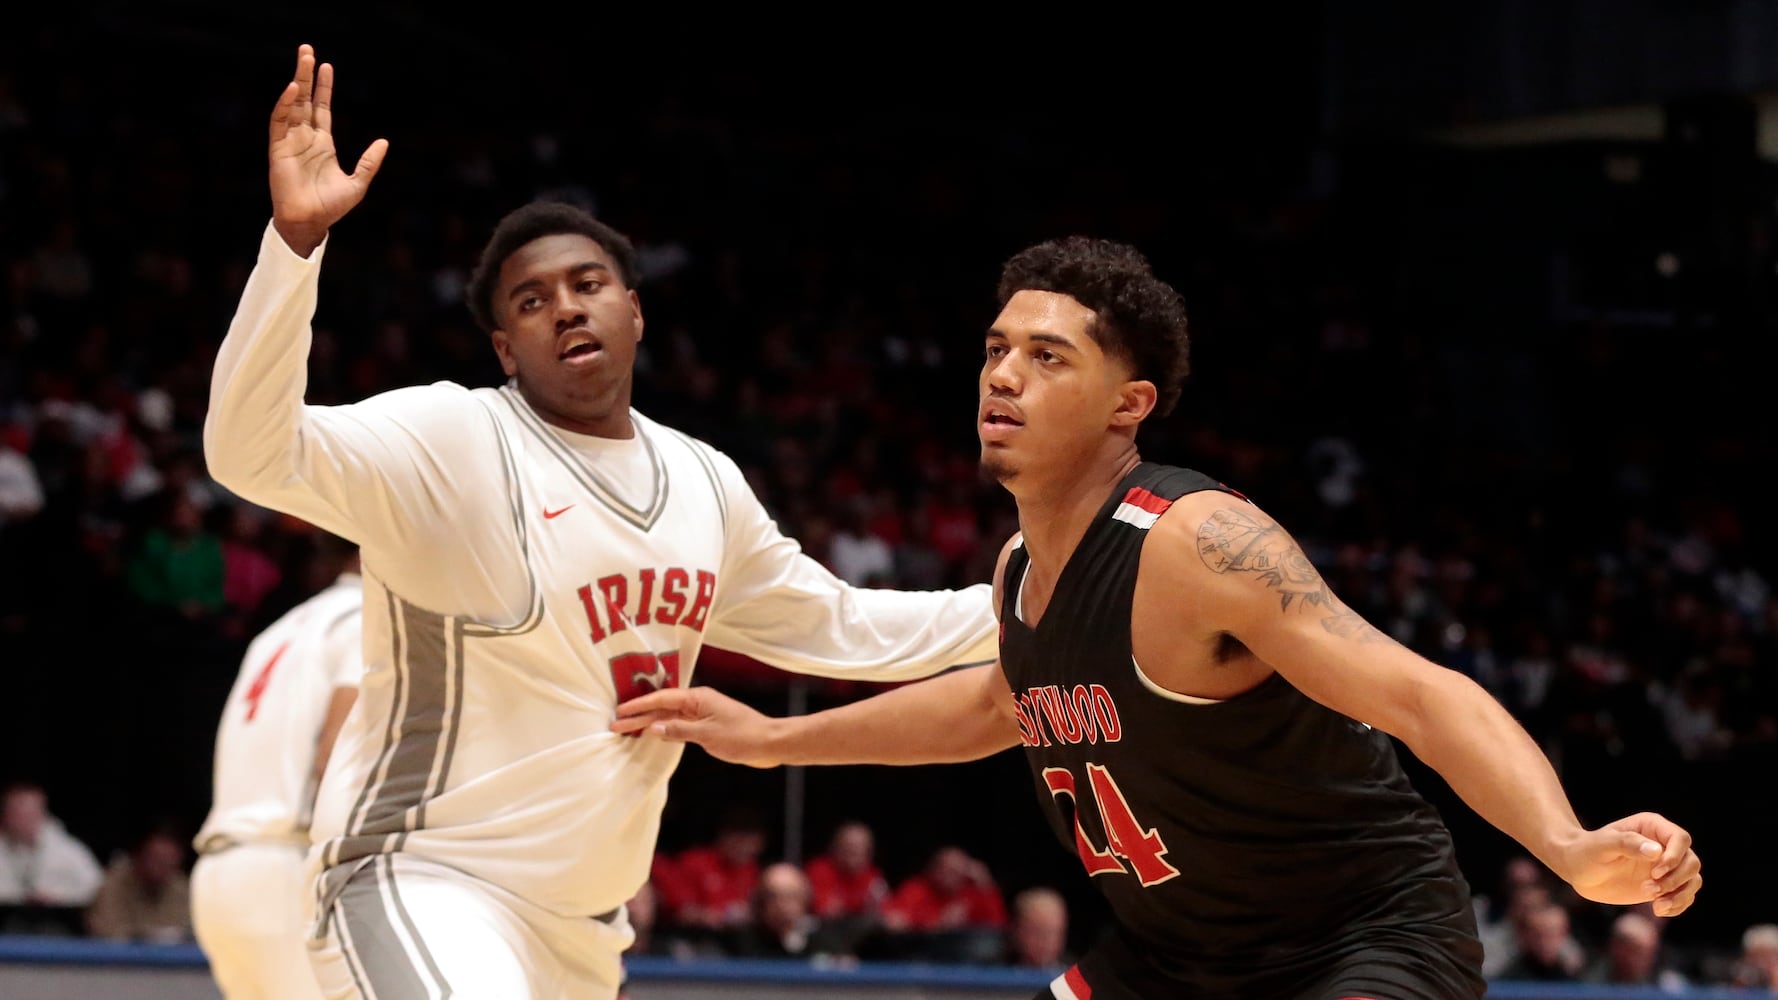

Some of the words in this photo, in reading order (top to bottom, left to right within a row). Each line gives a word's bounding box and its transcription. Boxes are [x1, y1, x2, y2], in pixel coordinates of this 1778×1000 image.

[577, 567, 716, 644] IRISH
[246, 641, 290, 723] 4
[1042, 762, 1181, 888] 24
